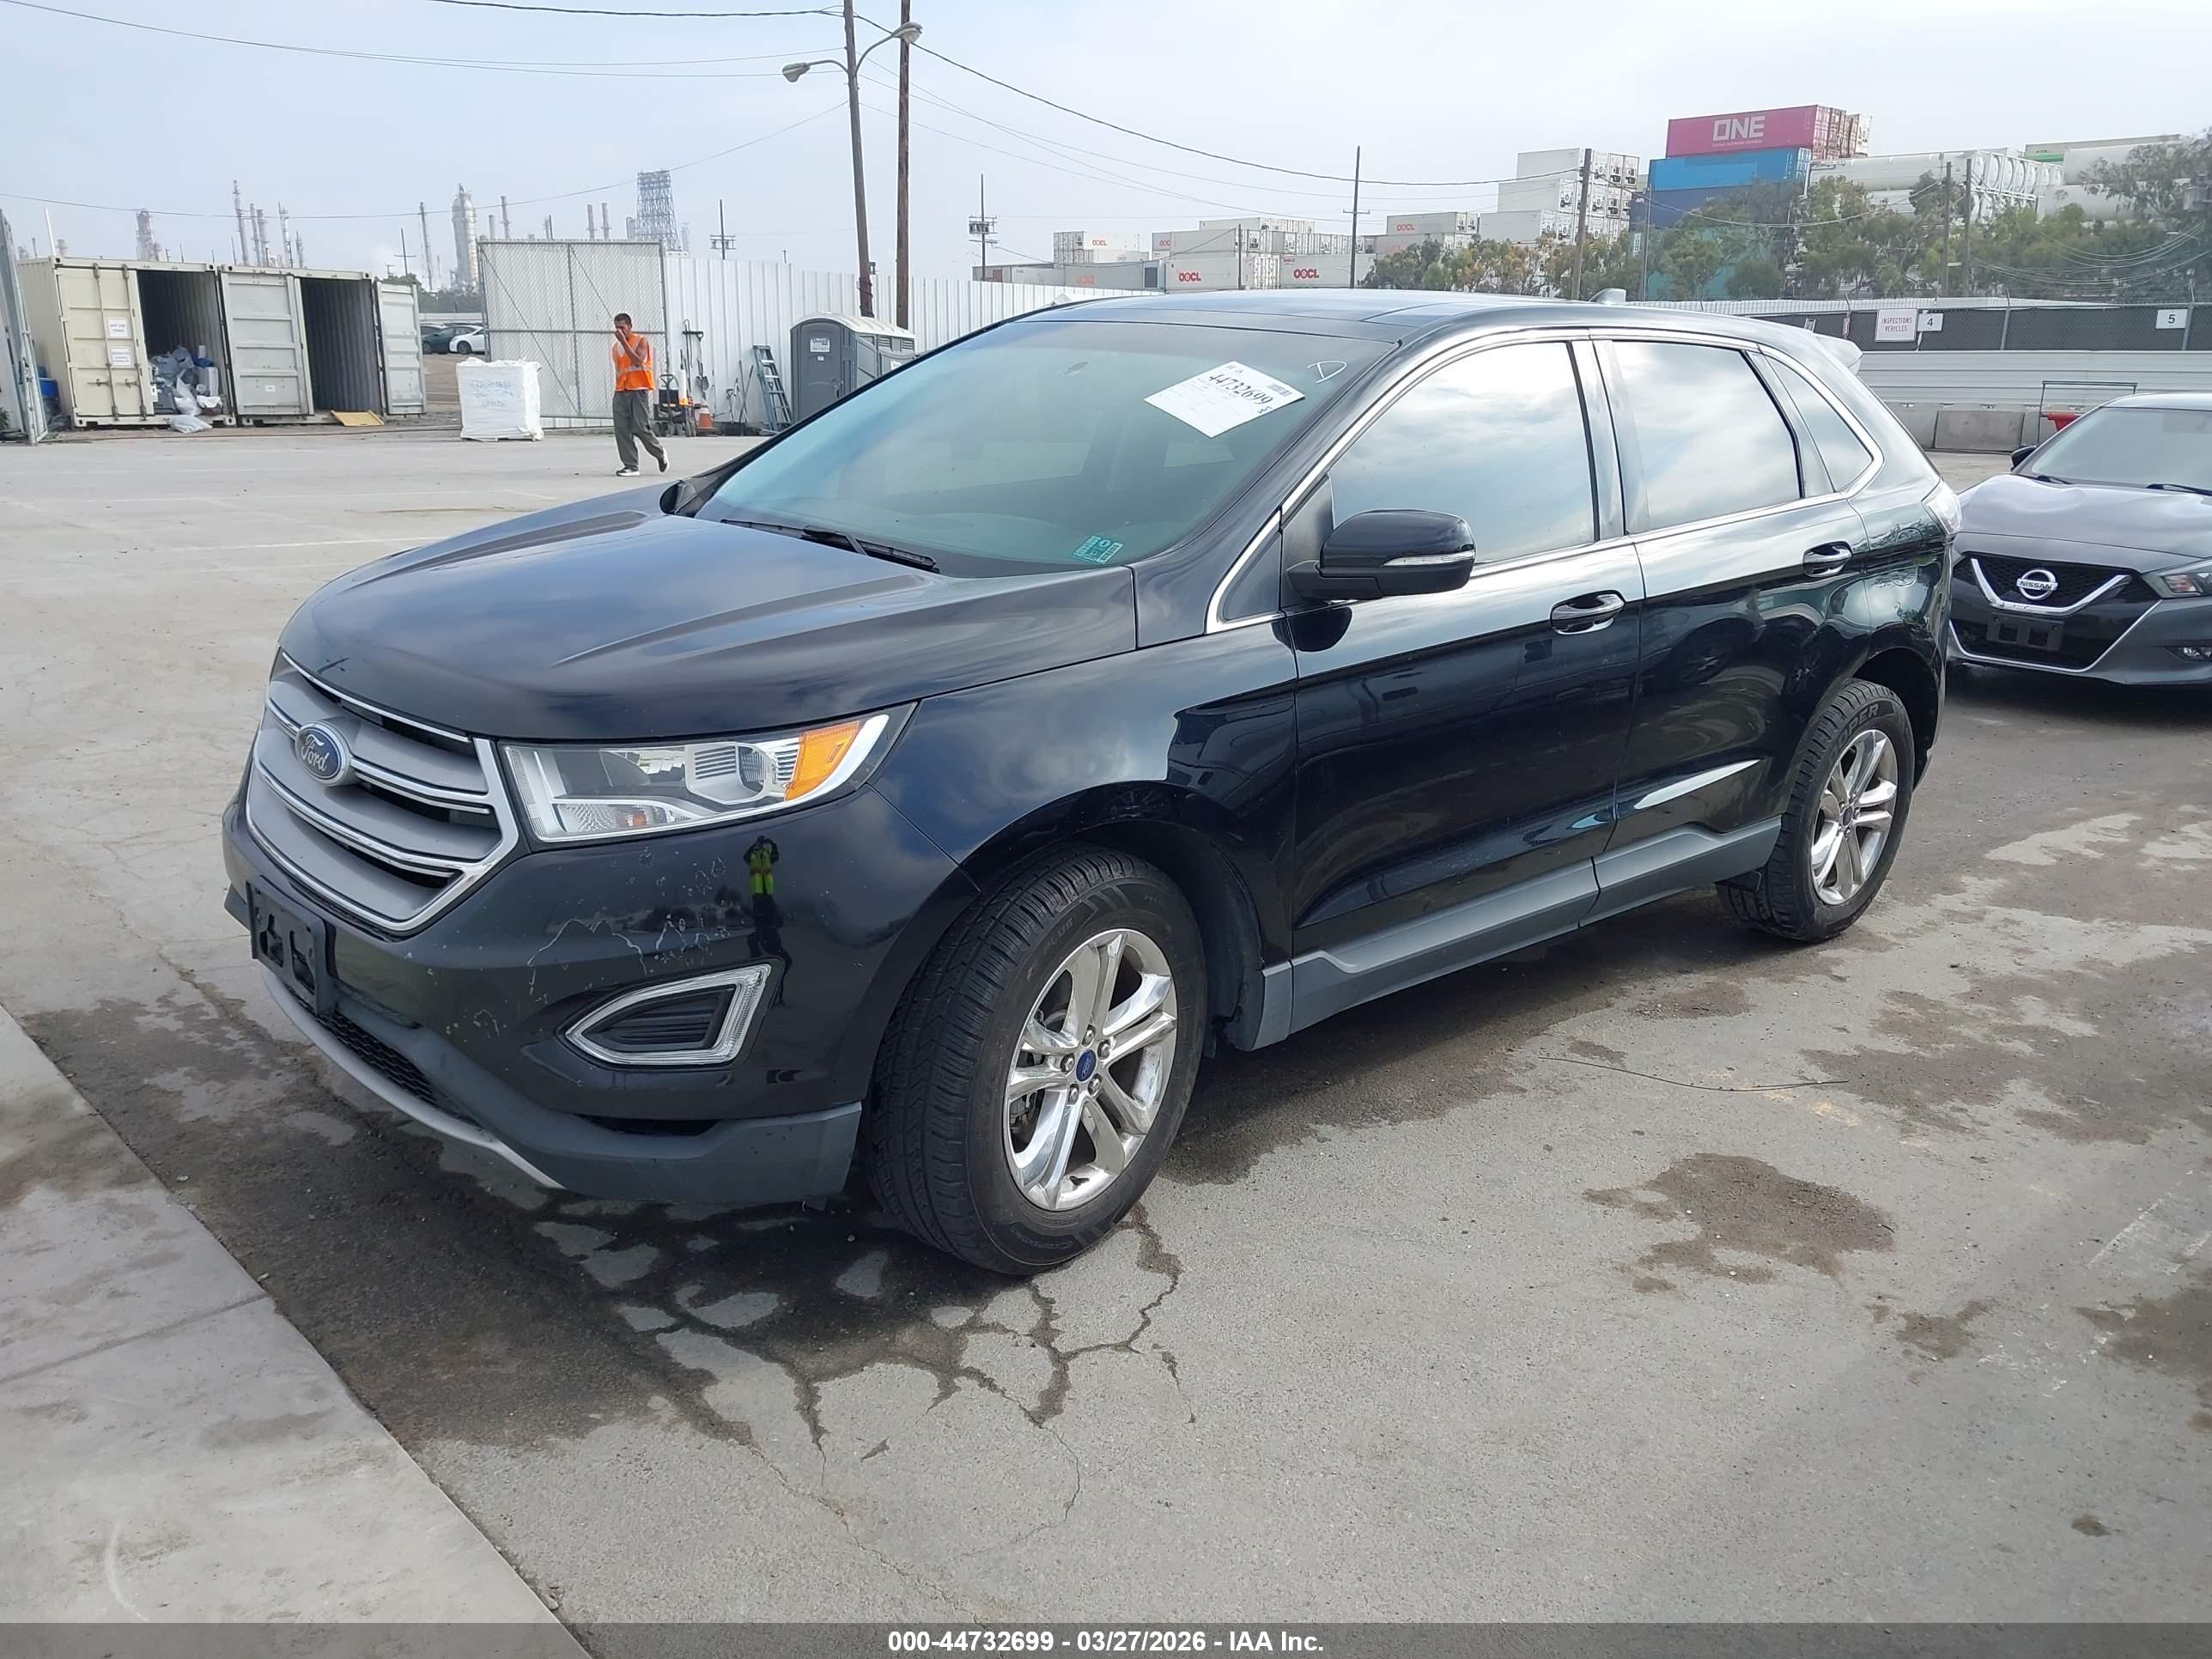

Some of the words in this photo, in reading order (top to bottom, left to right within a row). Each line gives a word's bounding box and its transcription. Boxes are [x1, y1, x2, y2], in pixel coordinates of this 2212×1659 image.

[1713, 115, 1765, 141] ONE
[1396, 223, 1415, 232] OOCL
[1178, 272, 1201, 282] OOCL
[1293, 269, 1320, 279] OOCL
[1926, 318, 1934, 326] 4
[2167, 313, 2176, 324] 5
[1208, 374, 1273, 404] 44732699
[2020, 580, 2052, 589] NISSAN
[301, 733, 331, 771] Ford
